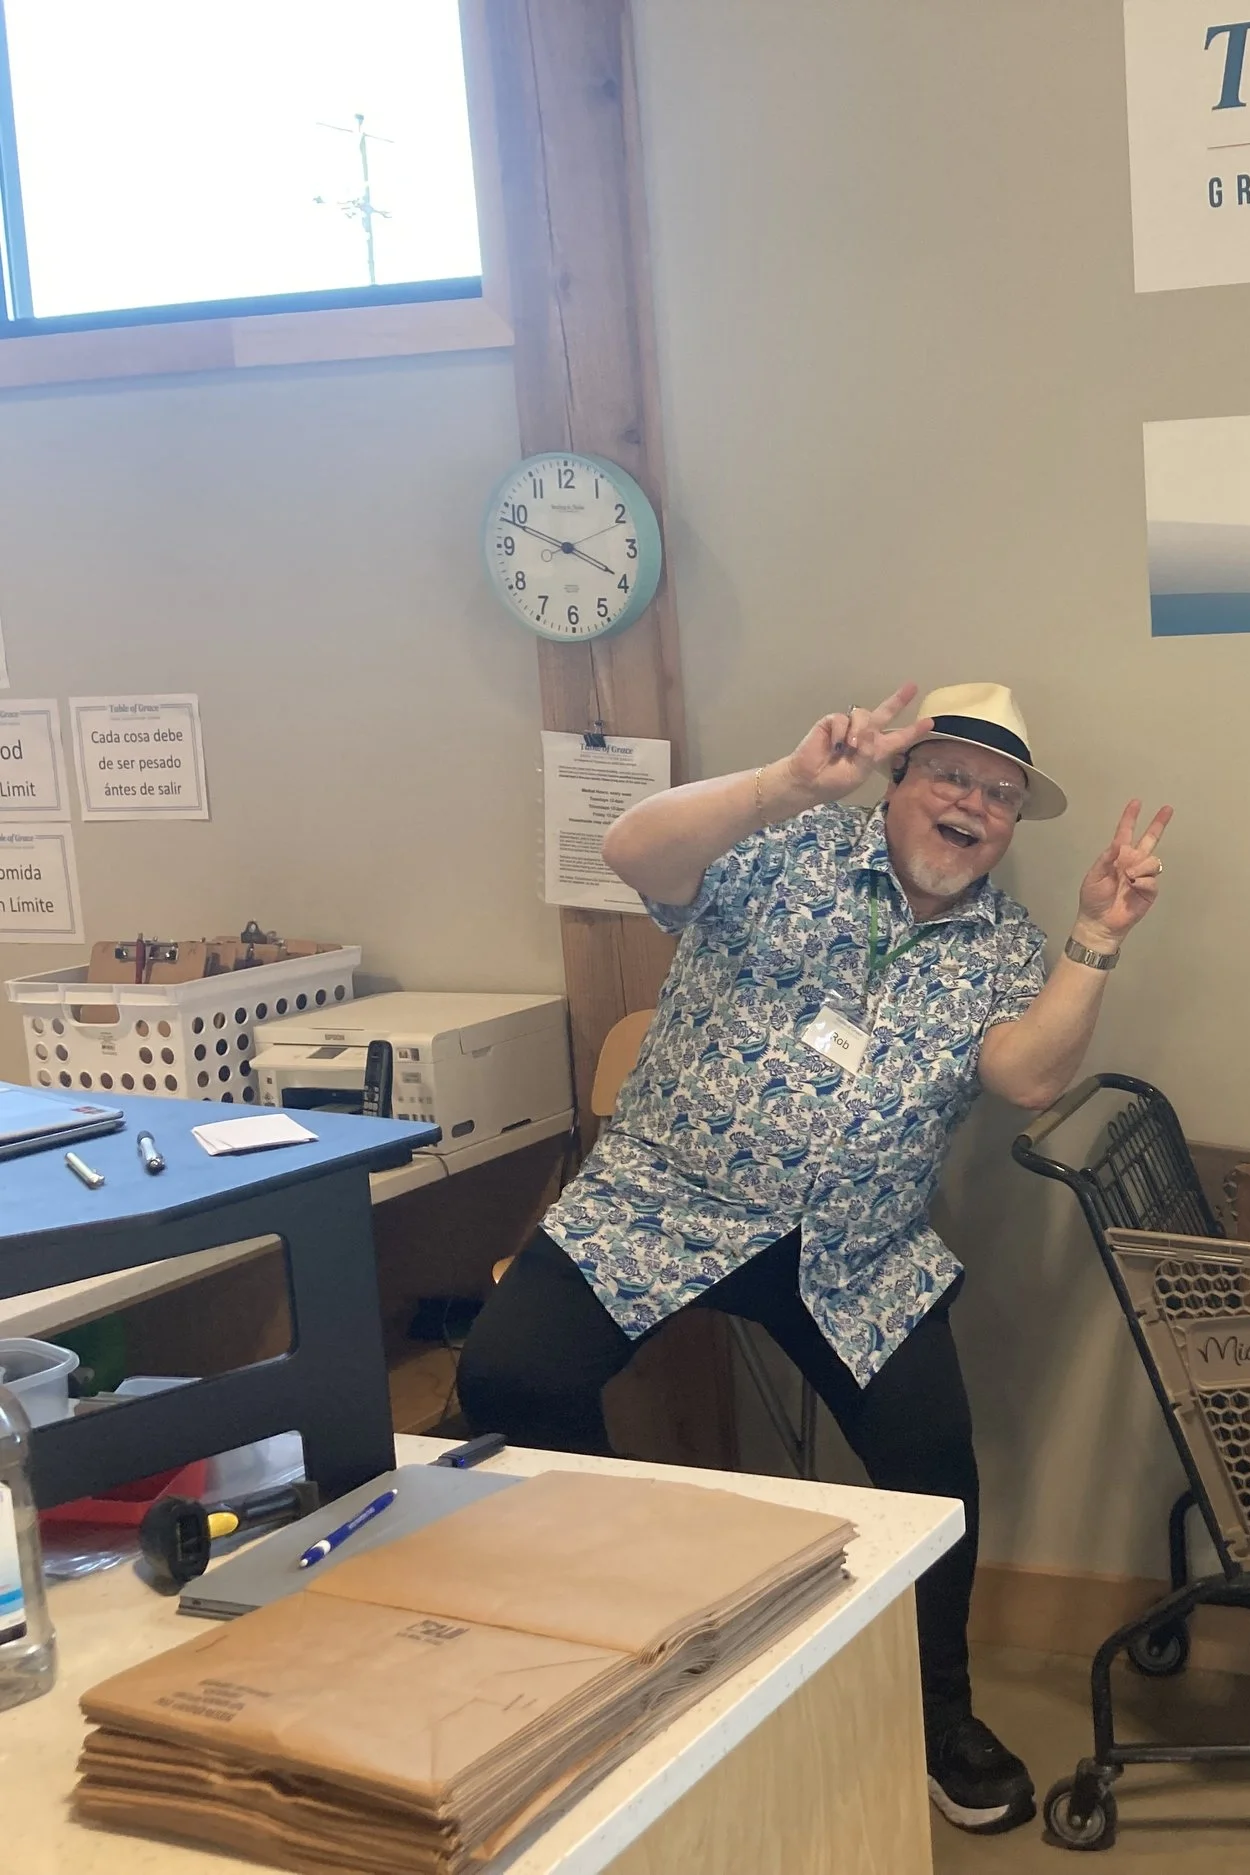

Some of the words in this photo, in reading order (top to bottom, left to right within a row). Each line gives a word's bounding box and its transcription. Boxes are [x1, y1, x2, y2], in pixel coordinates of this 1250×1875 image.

[557, 468, 576, 489] 12
[511, 503, 528, 524] 10
[614, 503, 626, 524] 2
[503, 536, 515, 556] 9
[625, 538, 638, 559] 3
[514, 570, 526, 590] 8
[617, 573, 630, 594] 4
[537, 595, 549, 615] 7
[567, 605, 580, 625] 6
[597, 597, 609, 617] 5
[91, 730, 121, 744] Cada
[123, 732, 150, 743] cosa
[153, 728, 183, 742] debe
[0, 739, 23, 760] od
[98, 756, 114, 770] de
[117, 759, 135, 770] ser
[138, 754, 181, 772] pesado
[0, 780, 36, 797] Limit
[140, 782, 155, 796] de
[158, 780, 182, 796] salir
[0, 864, 42, 880] omida
